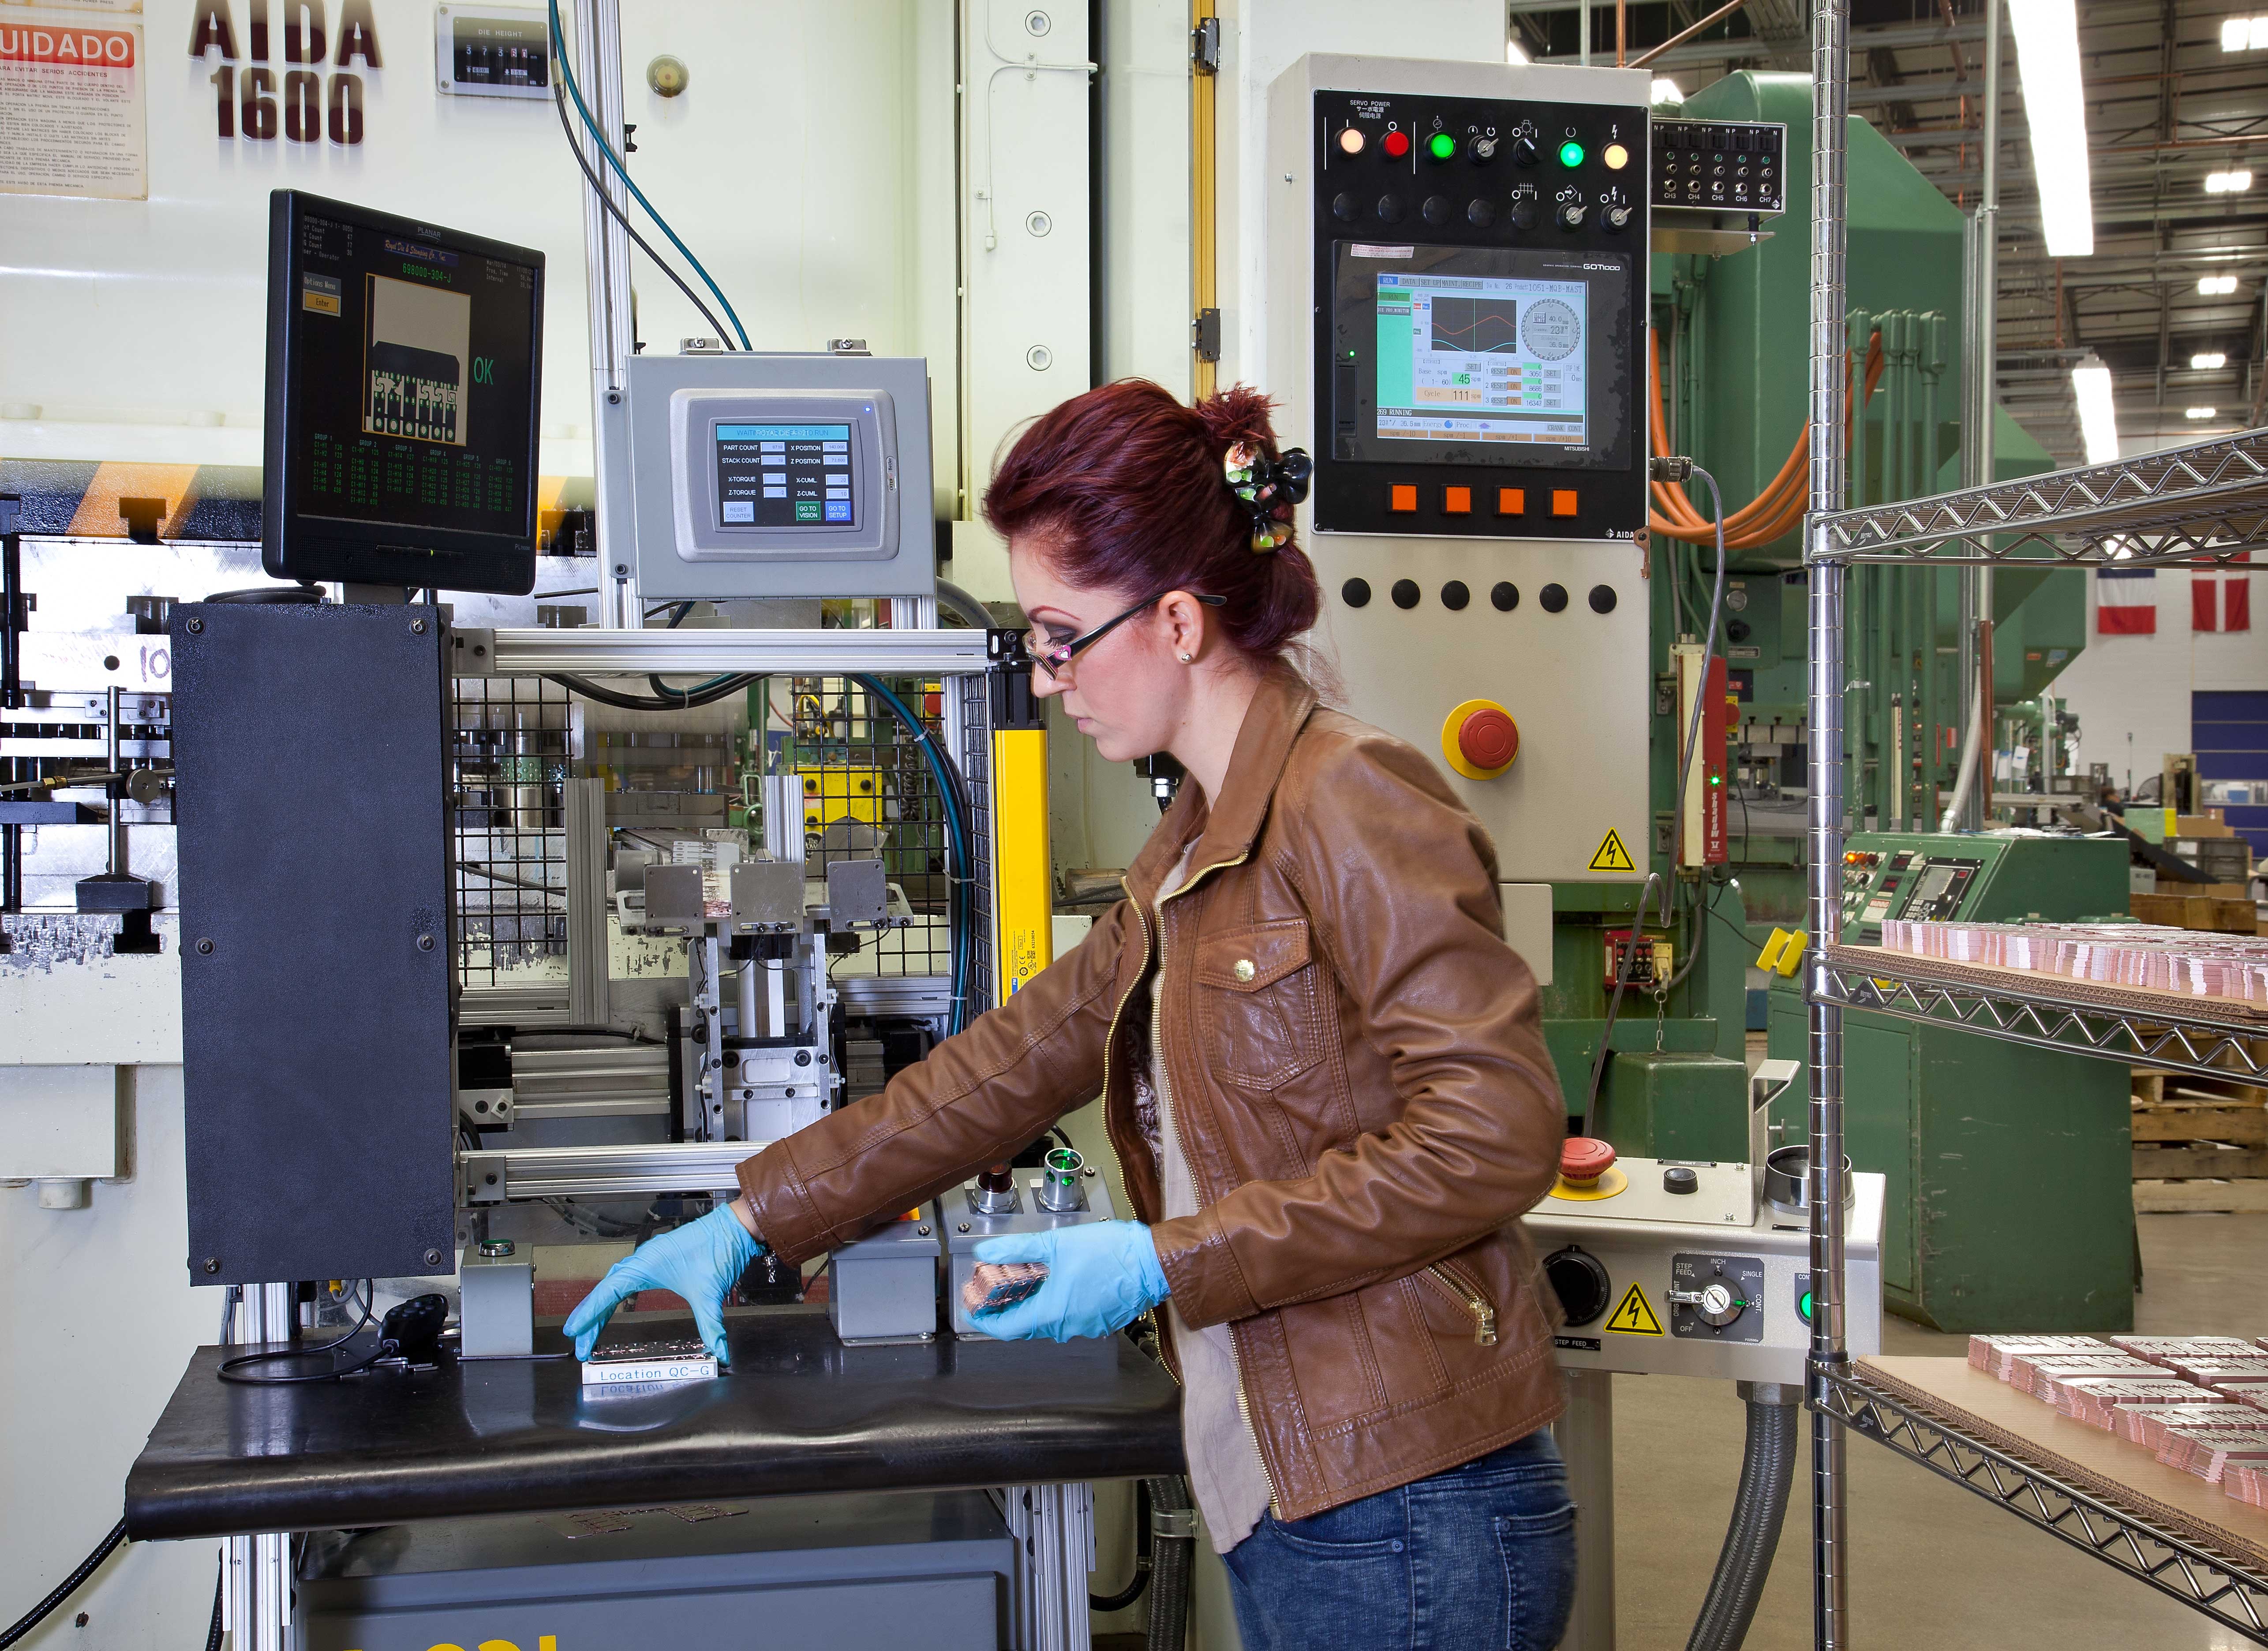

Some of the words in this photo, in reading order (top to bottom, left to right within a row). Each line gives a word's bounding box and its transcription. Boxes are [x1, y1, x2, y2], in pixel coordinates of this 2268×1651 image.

[188, 0, 384, 67] AIDA
[0, 29, 128, 61] UIDADO
[210, 66, 364, 144] 1600
[418, 227, 441, 238] PLANAR
[403, 263, 451, 283] 698000-304-J
[304, 276, 323, 288] Options
[1529, 285, 1583, 293] 1051-MQB-MAST
[316, 298, 329, 308] Enter
[473, 356, 494, 386] OK
[1459, 374, 1470, 384] 45
[1453, 391, 1468, 400] 111
[140, 646, 171, 683] 10
[1860, 990, 1871, 998] METRO
[600, 1369, 661, 1381] Location
[669, 1365, 709, 1378] QC-G
[1862, 1414, 1874, 1426] METRO
